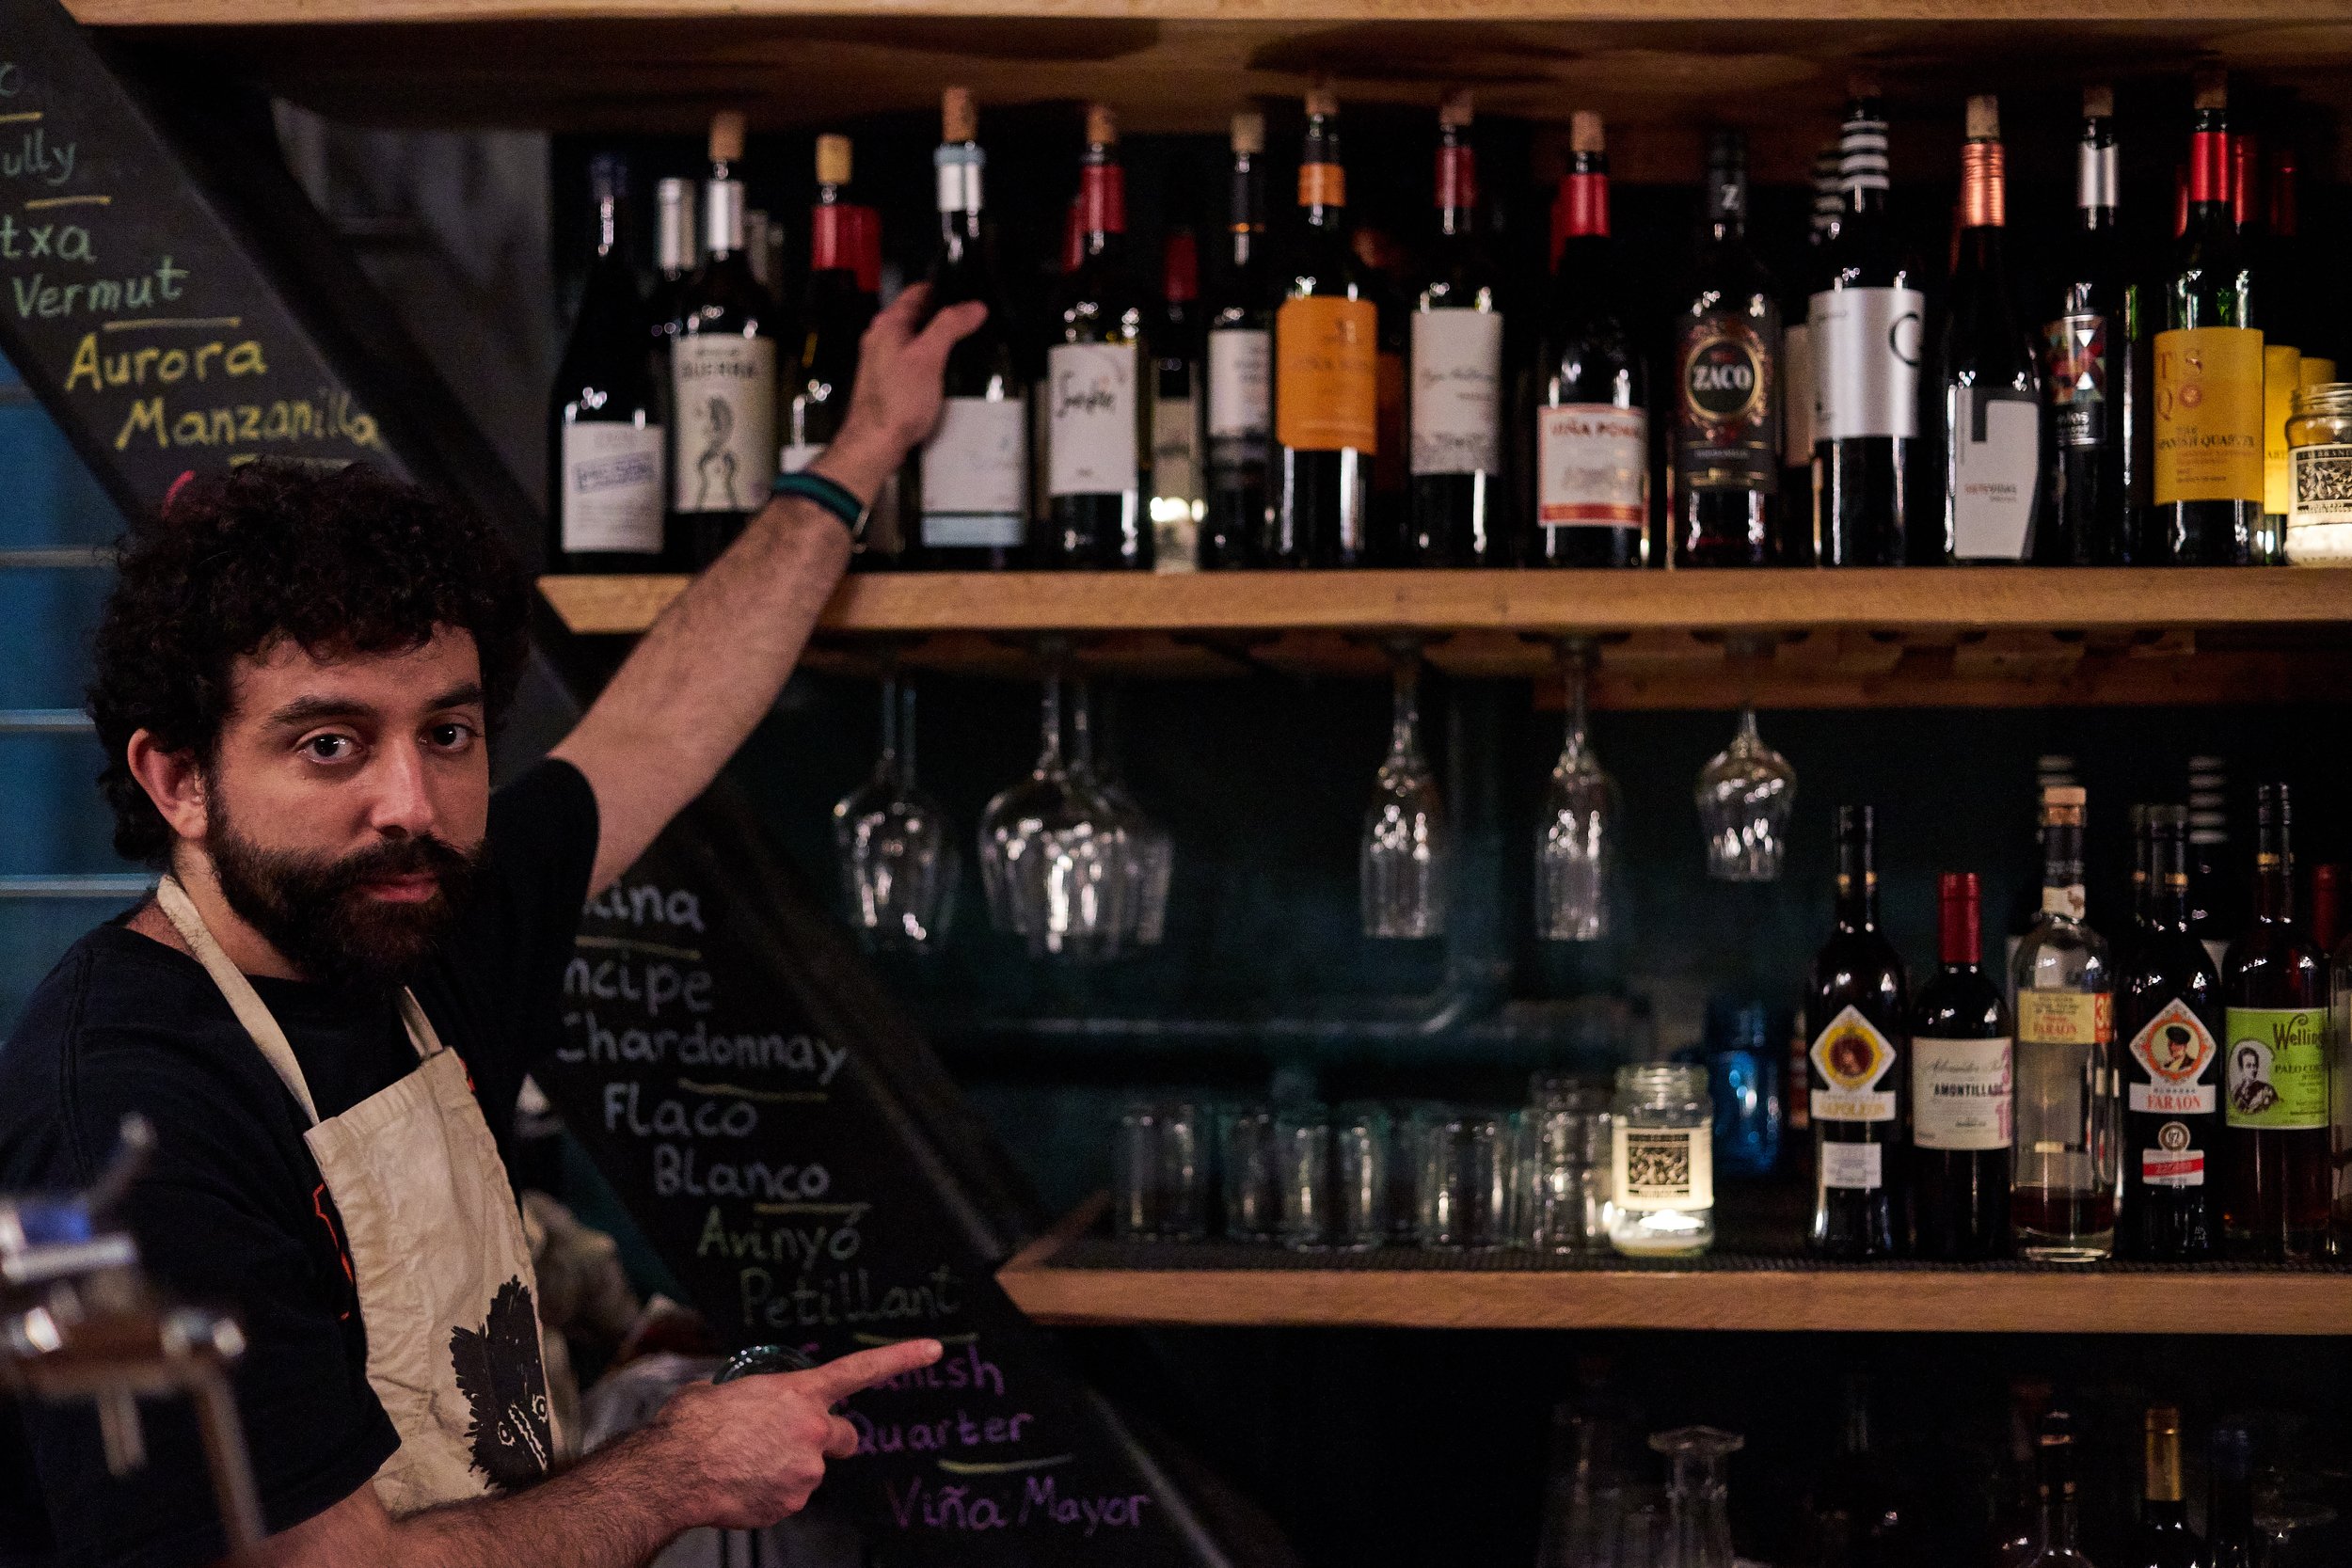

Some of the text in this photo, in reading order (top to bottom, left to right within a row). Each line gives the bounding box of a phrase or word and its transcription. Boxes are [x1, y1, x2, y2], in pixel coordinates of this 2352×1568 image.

[12, 257, 188, 318] Vermut
[65, 331, 268, 391] Aurora
[114, 384, 384, 454] Manzanilla
[843, 1410, 1035, 1455] Quarter
[884, 1475, 1152, 1537] Viña Mayor
